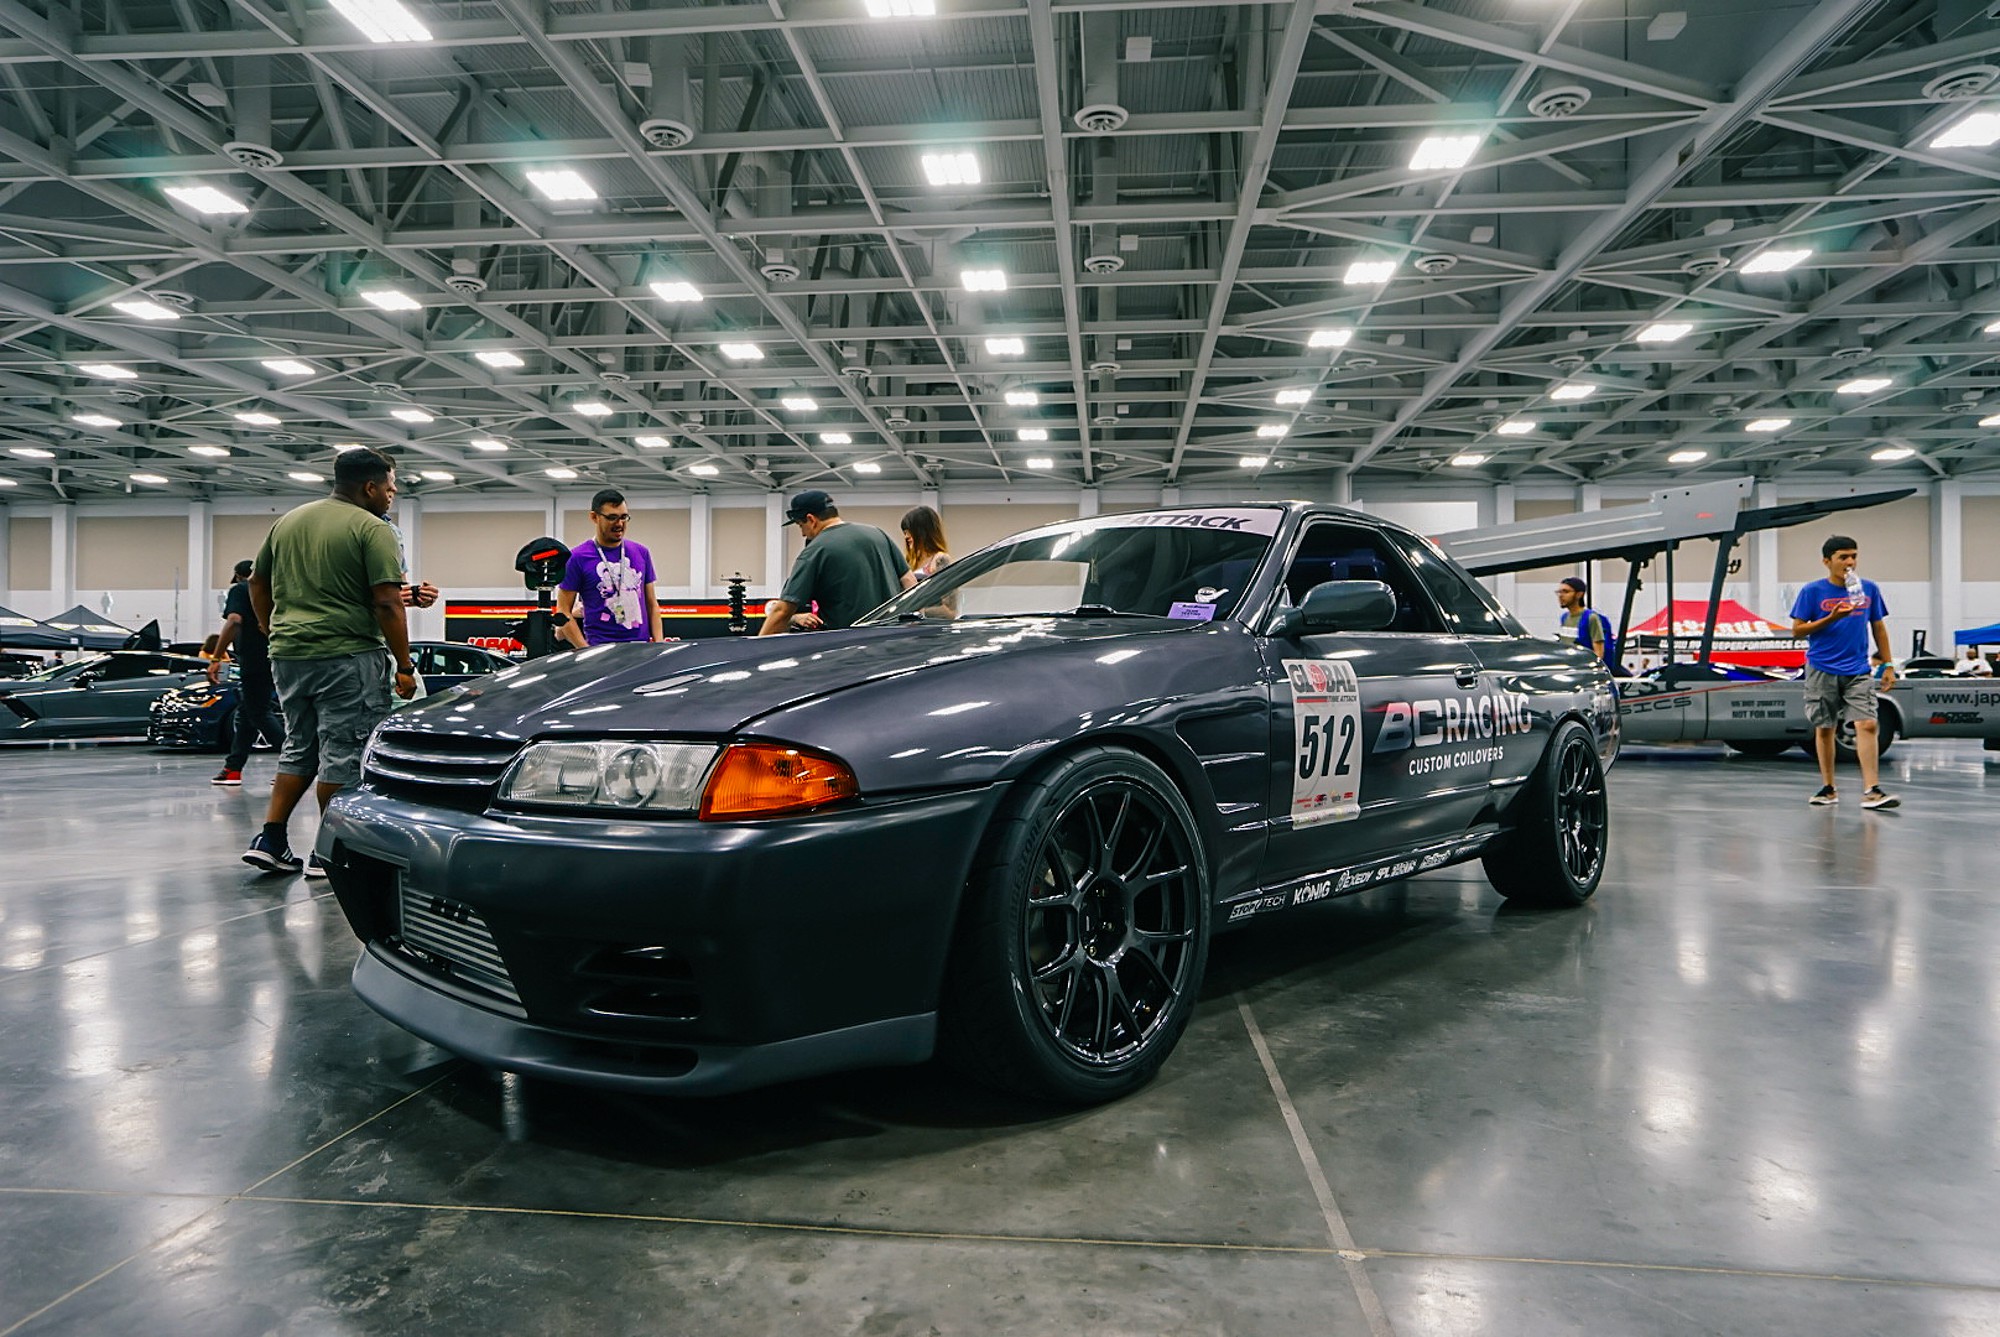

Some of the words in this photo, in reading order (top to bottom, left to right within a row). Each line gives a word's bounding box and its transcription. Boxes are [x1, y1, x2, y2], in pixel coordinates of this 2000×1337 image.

[1129, 514, 1252, 530] ATTACK
[1288, 664, 1357, 693] GLOBAL
[1373, 701, 1443, 753] BC
[1445, 694, 1532, 743] RACING
[1300, 715, 1355, 779] 512
[1408, 754, 1451, 775] CUSTOM
[1453, 746, 1504, 767] COILOVERS
[1292, 880, 1331, 906] KÖNIG
